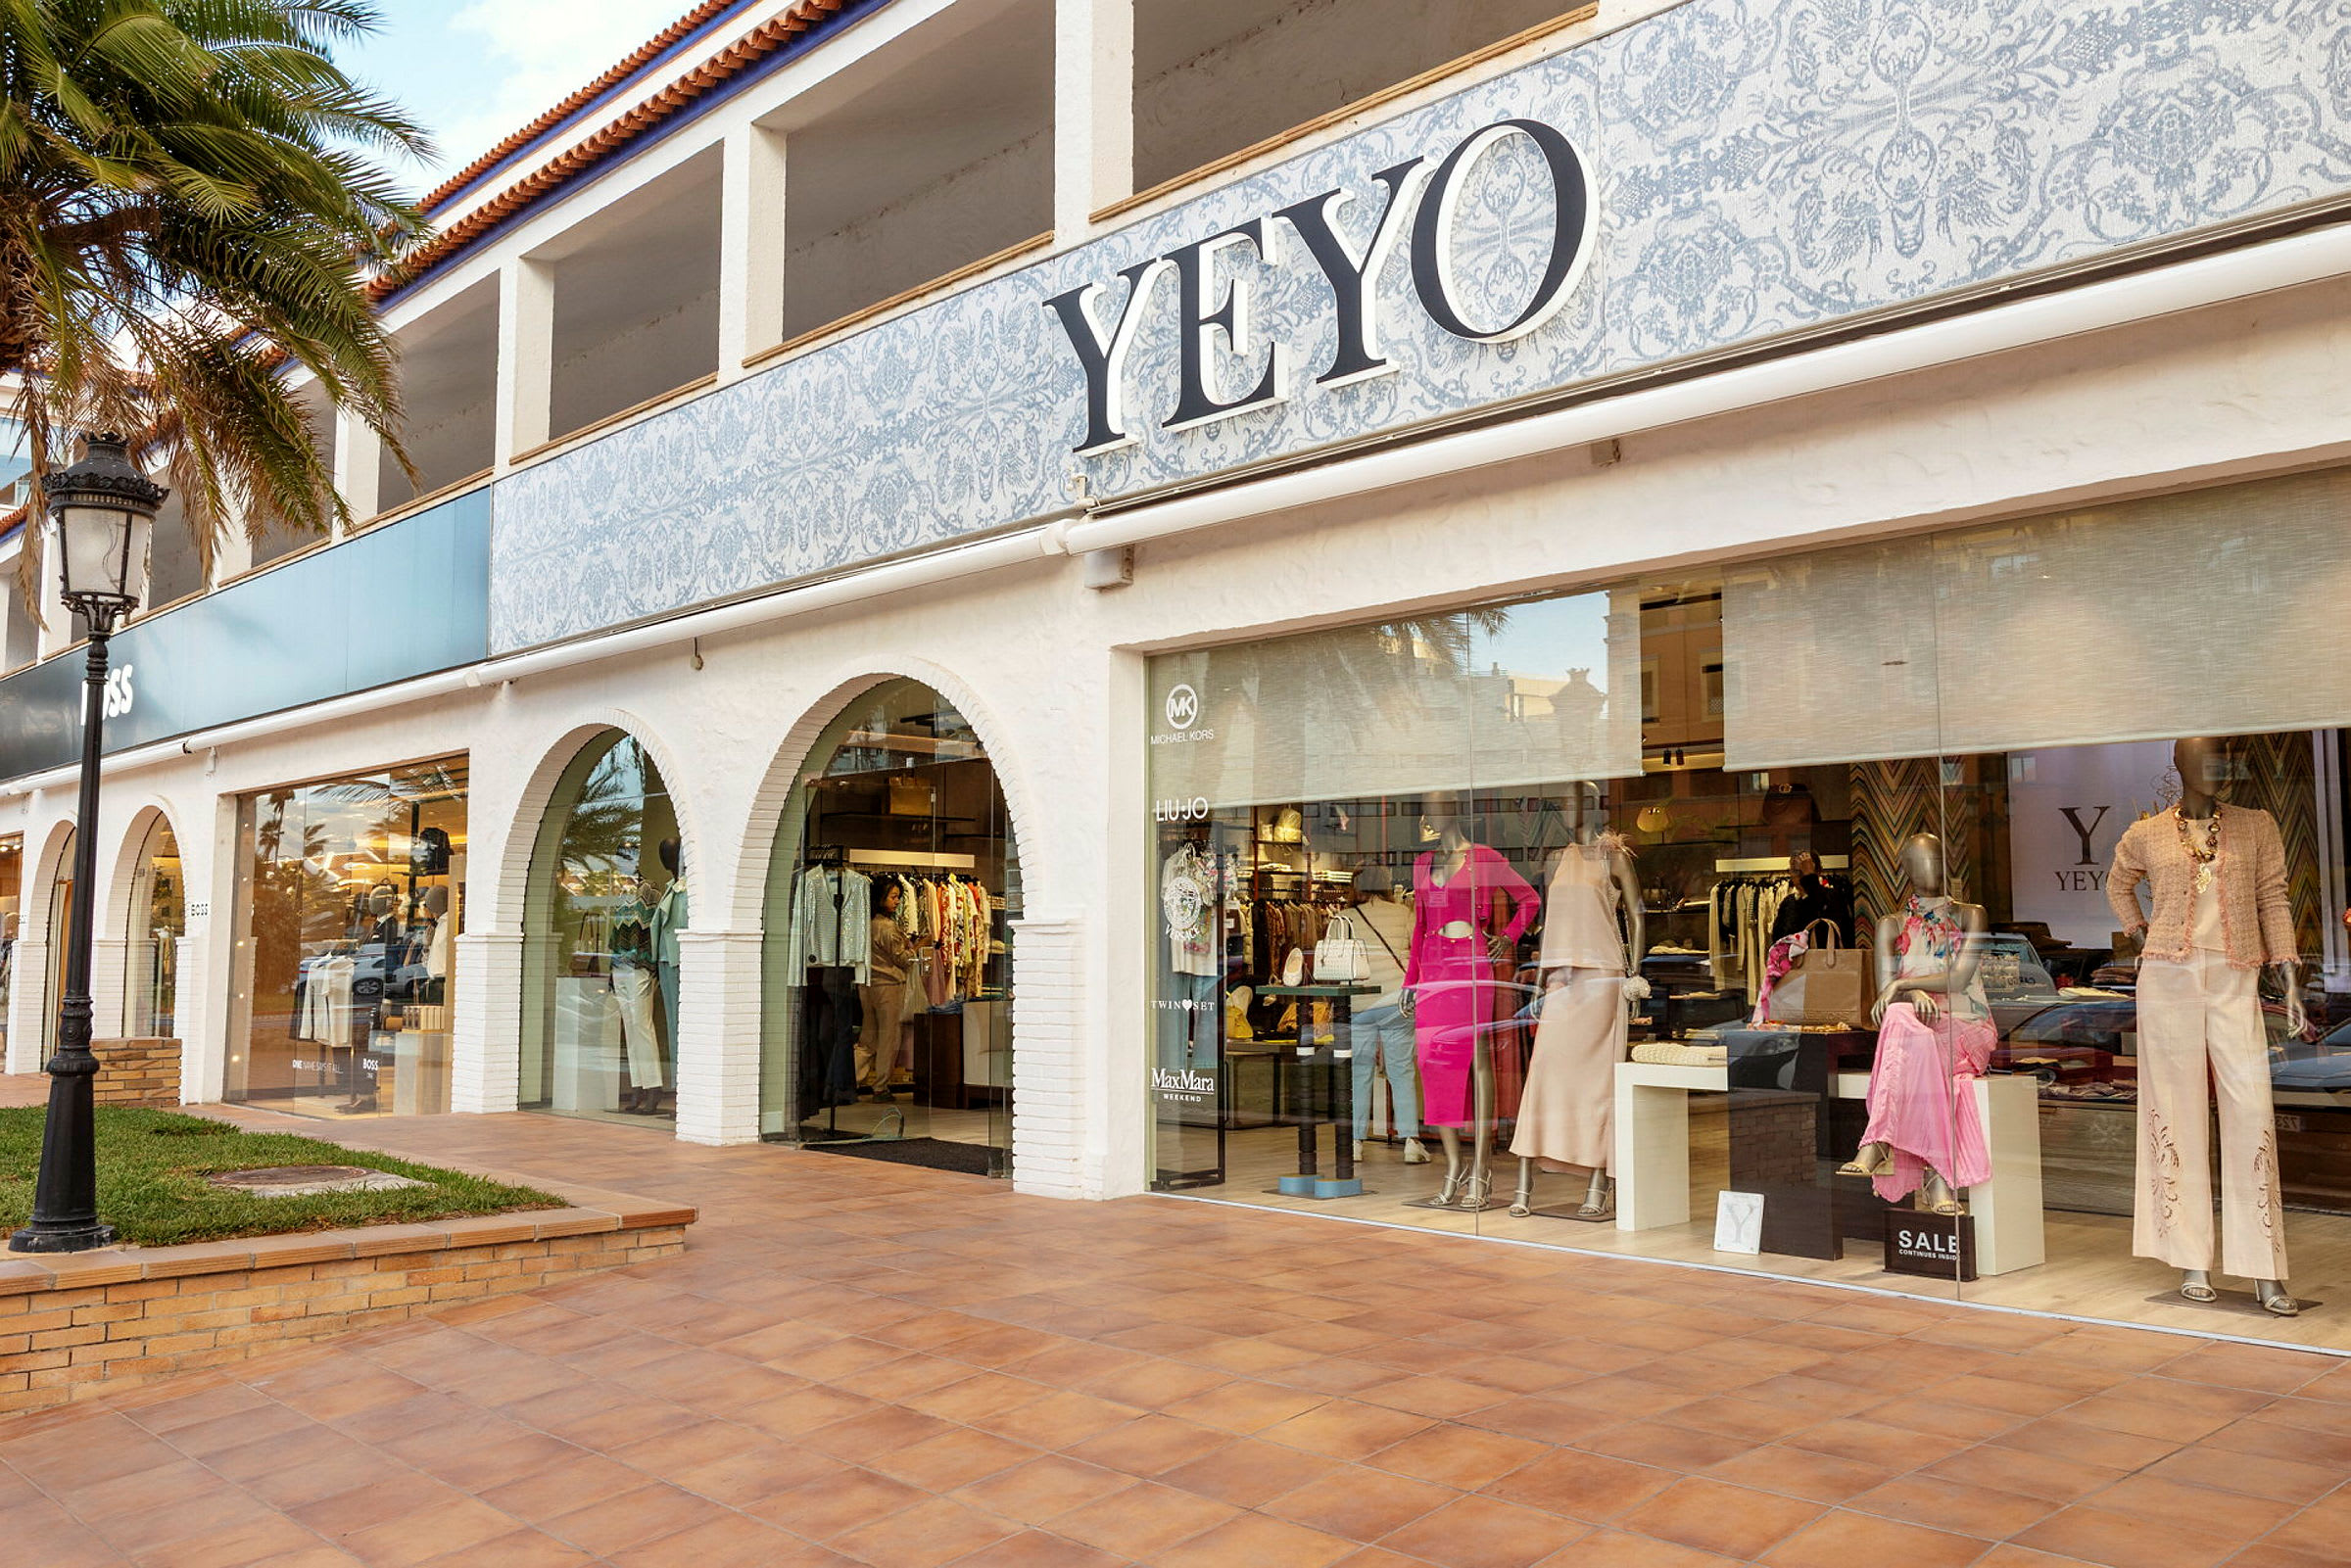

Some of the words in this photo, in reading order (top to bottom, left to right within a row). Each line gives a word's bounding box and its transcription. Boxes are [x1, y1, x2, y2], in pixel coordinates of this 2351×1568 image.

[1042, 118, 1599, 455] YEYO
[80, 664, 133, 726] SS
[1150, 732, 1188, 744] MICHAEL
[1189, 729, 1215, 741] KORS
[2058, 806, 2111, 866] Y
[2054, 870, 2111, 891] YEY
[190, 903, 208, 917] BOSS
[292, 1059, 303, 1069] ONE
[362, 1058, 379, 1071] BOSS
[1150, 1068, 1215, 1092] MaxMara
[1163, 1093, 1202, 1103] WEEKEND
[1898, 1230, 1960, 1254] SALE
[1898, 1249, 1937, 1259] CONTINUES
